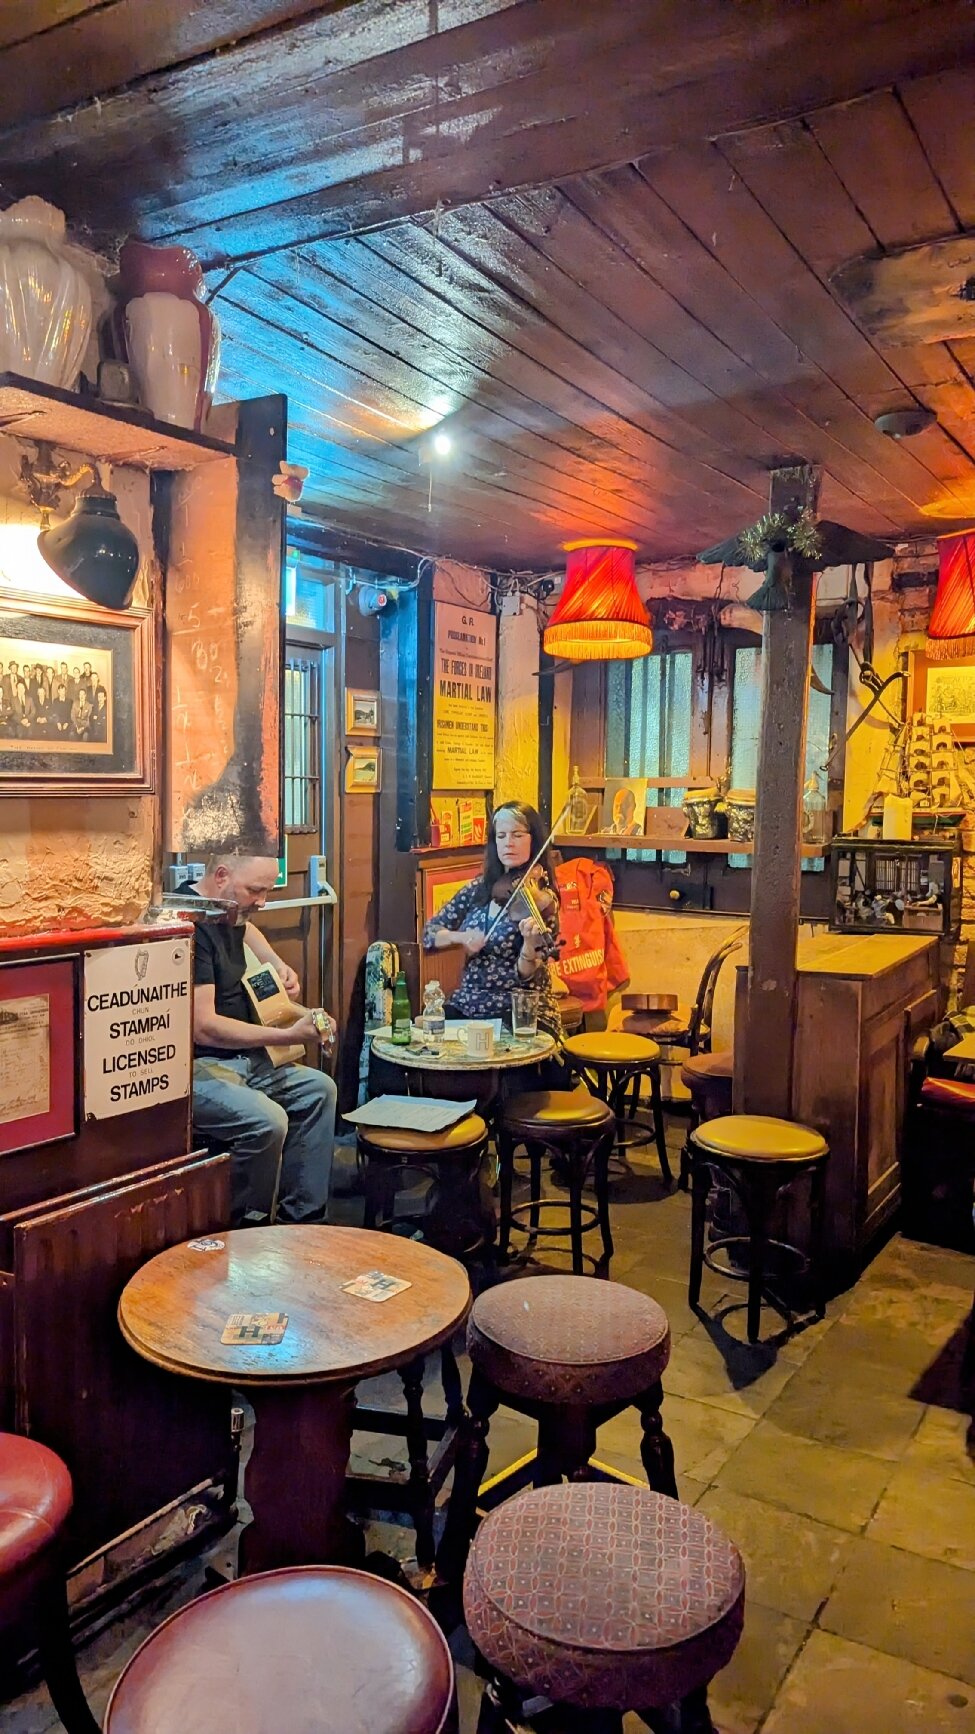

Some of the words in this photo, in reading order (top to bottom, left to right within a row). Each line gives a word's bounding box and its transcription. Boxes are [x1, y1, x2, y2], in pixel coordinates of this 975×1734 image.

[440, 680, 473, 701] MARTIAL
[477, 685, 492, 703] LAW
[447, 746, 467, 754] MARTIAL
[87, 981, 188, 1012] CEADÚNAITHE
[132, 1007, 149, 1015] CHUN
[109, 1008, 170, 1039] STAMPAÍ
[475, 1032, 490, 1051] H
[102, 1044, 176, 1074] LICENSED
[140, 1068, 154, 1076] SELL
[110, 1074, 169, 1102] STAMPS
